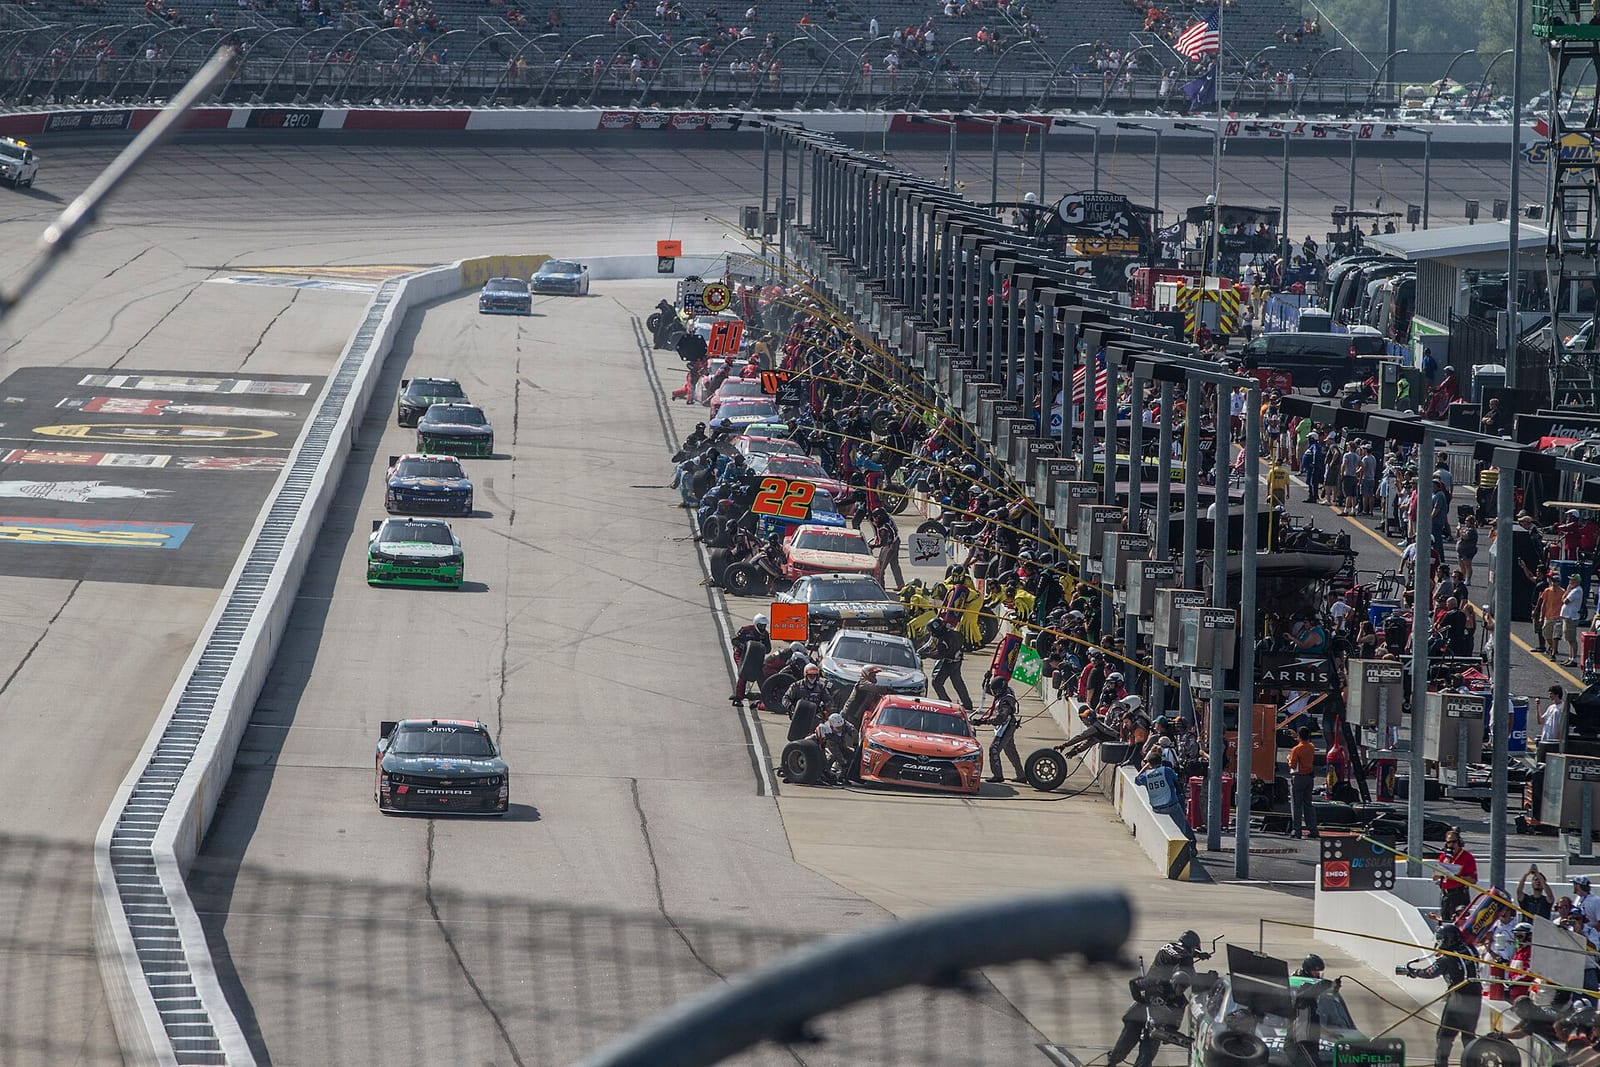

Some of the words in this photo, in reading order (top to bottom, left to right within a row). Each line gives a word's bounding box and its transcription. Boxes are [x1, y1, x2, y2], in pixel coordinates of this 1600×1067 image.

[282, 113, 310, 127] zero
[707, 320, 745, 356] 60
[751, 477, 816, 520] 22
[1120, 539, 1148, 547] musco
[1144, 567, 1174, 575] musco
[1174, 597, 1205, 605] musco
[1203, 615, 1235, 624] musco
[1262, 670, 1329, 683] ARRIS
[1366, 669, 1402, 678] musco
[910, 704, 940, 713] xfinity
[1447, 703, 1484, 713] musco
[426, 726, 458, 734] xfinity
[902, 763, 941, 772] CAMRY
[1472, 902, 1497, 934] SUNOCO
